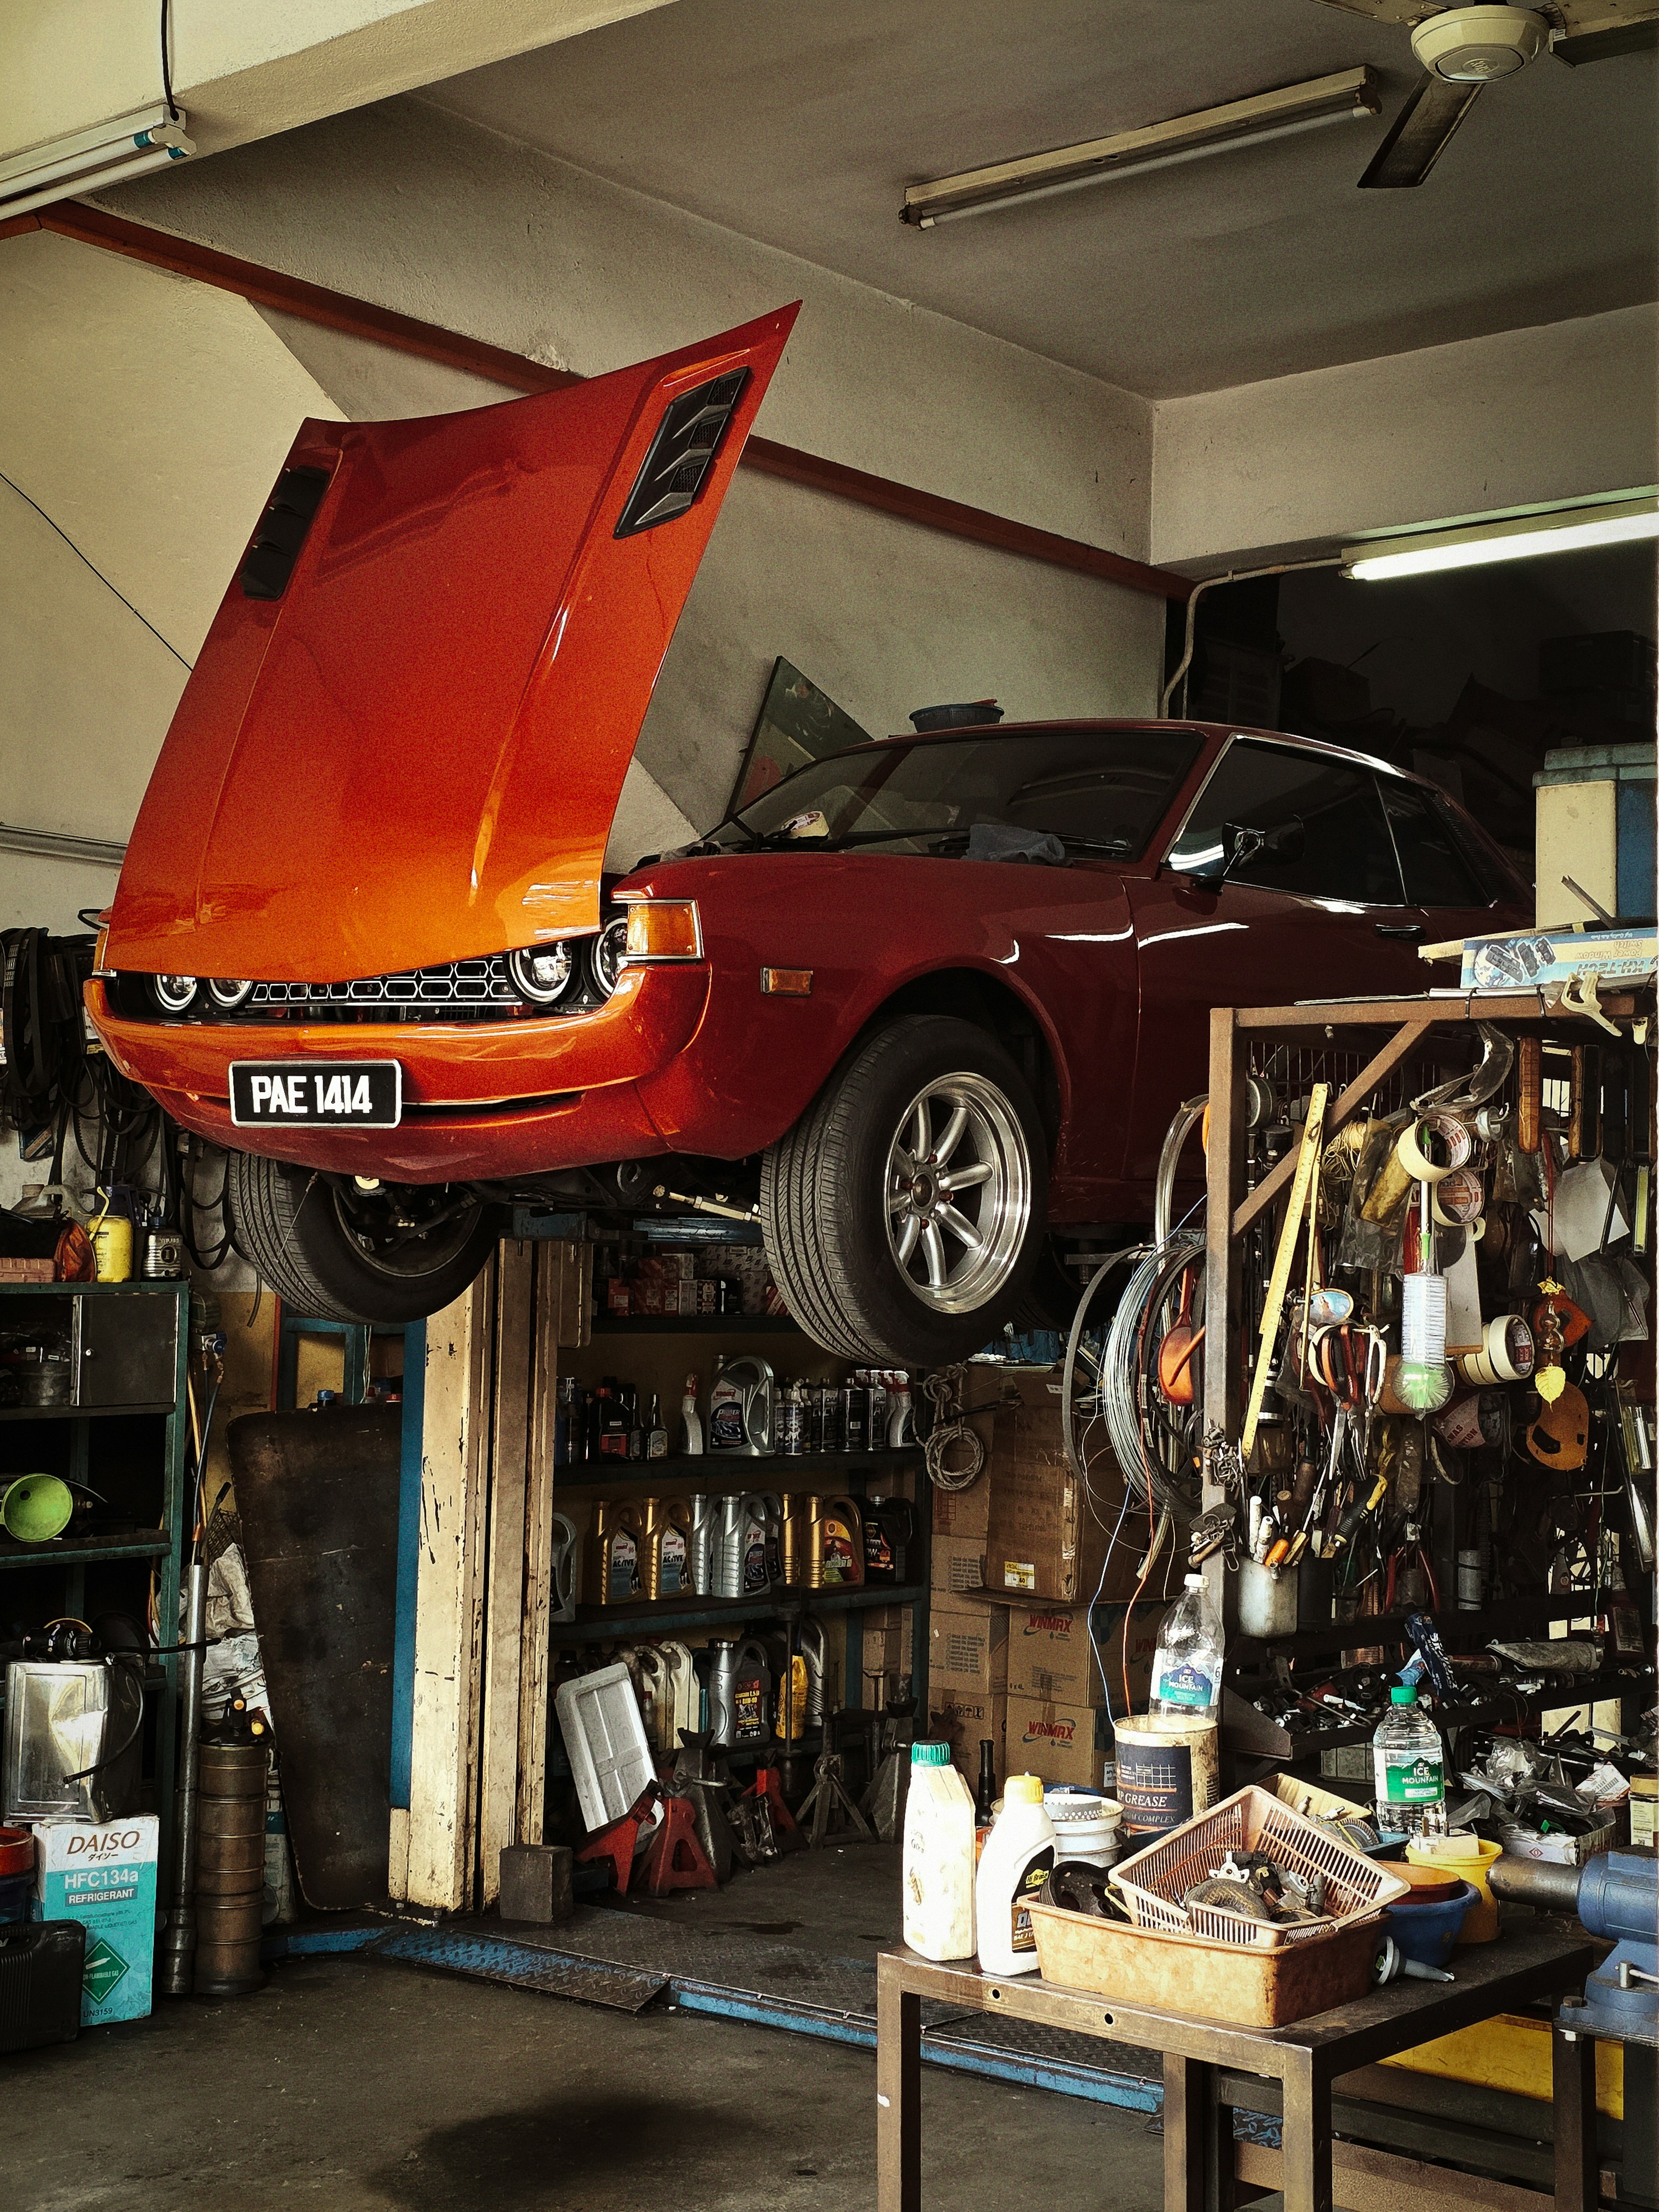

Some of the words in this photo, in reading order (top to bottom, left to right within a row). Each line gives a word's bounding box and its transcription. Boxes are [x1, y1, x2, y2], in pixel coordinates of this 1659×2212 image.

[1614, 940, 1643, 950] Switch
[1574, 951, 1612, 961] Window
[1613, 949, 1642, 958] Power
[251, 1076, 309, 1113] PAE
[315, 1075, 373, 1114] 1414
[1030, 1614, 1073, 1633] WINMAX
[1178, 1674, 1194, 1684] ICE
[1168, 1681, 1203, 1692] MOUNTAIN
[1029, 1721, 1075, 1740] WINMAX
[1413, 1767, 1431, 1777] ICE
[1402, 1775, 1438, 1785] MOUNTAIN
[1125, 1793, 1167, 1808] GREASE
[1138, 1813, 1176, 1824] COMPLEX
[66, 1830, 140, 1855] DAISO
[88, 1853, 119, 1862] ダイソー
[64, 1868, 139, 1890] HFC134a
[68, 1888, 135, 1905] REFRIGERANT
[83, 2006, 113, 2018] UN3159
